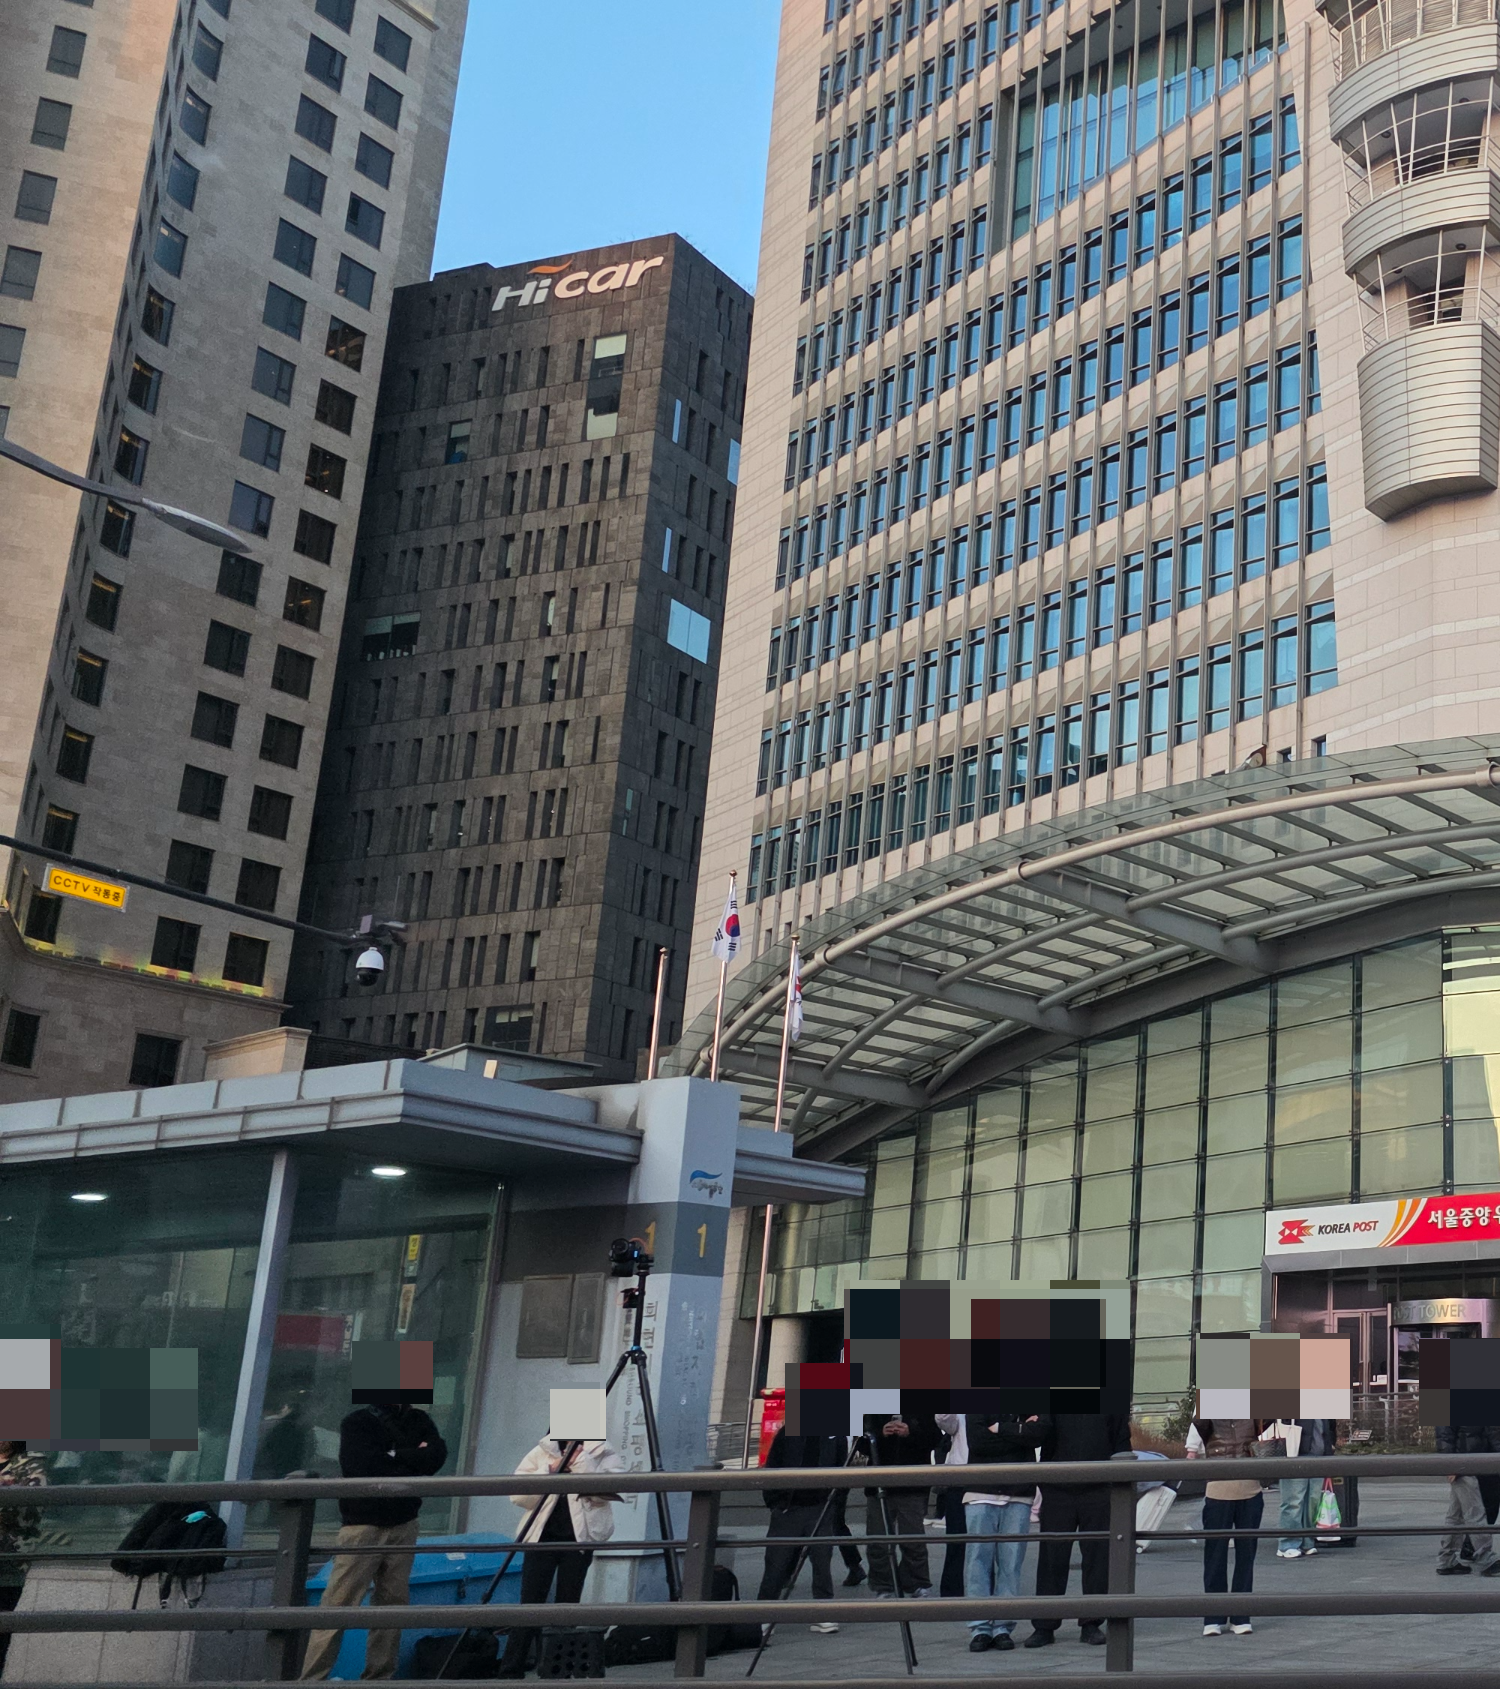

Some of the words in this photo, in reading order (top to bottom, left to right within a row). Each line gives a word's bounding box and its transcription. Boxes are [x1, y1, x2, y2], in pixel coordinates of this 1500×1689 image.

[53, 875, 91, 893] CCTV
[92, 885, 121, 902] 작동중
[1317, 1222, 1351, 1236] KOREA
[1352, 1220, 1379, 1233] POST
[697, 1223, 707, 1258] 1
[1418, 1303, 1467, 1319] TOWER
